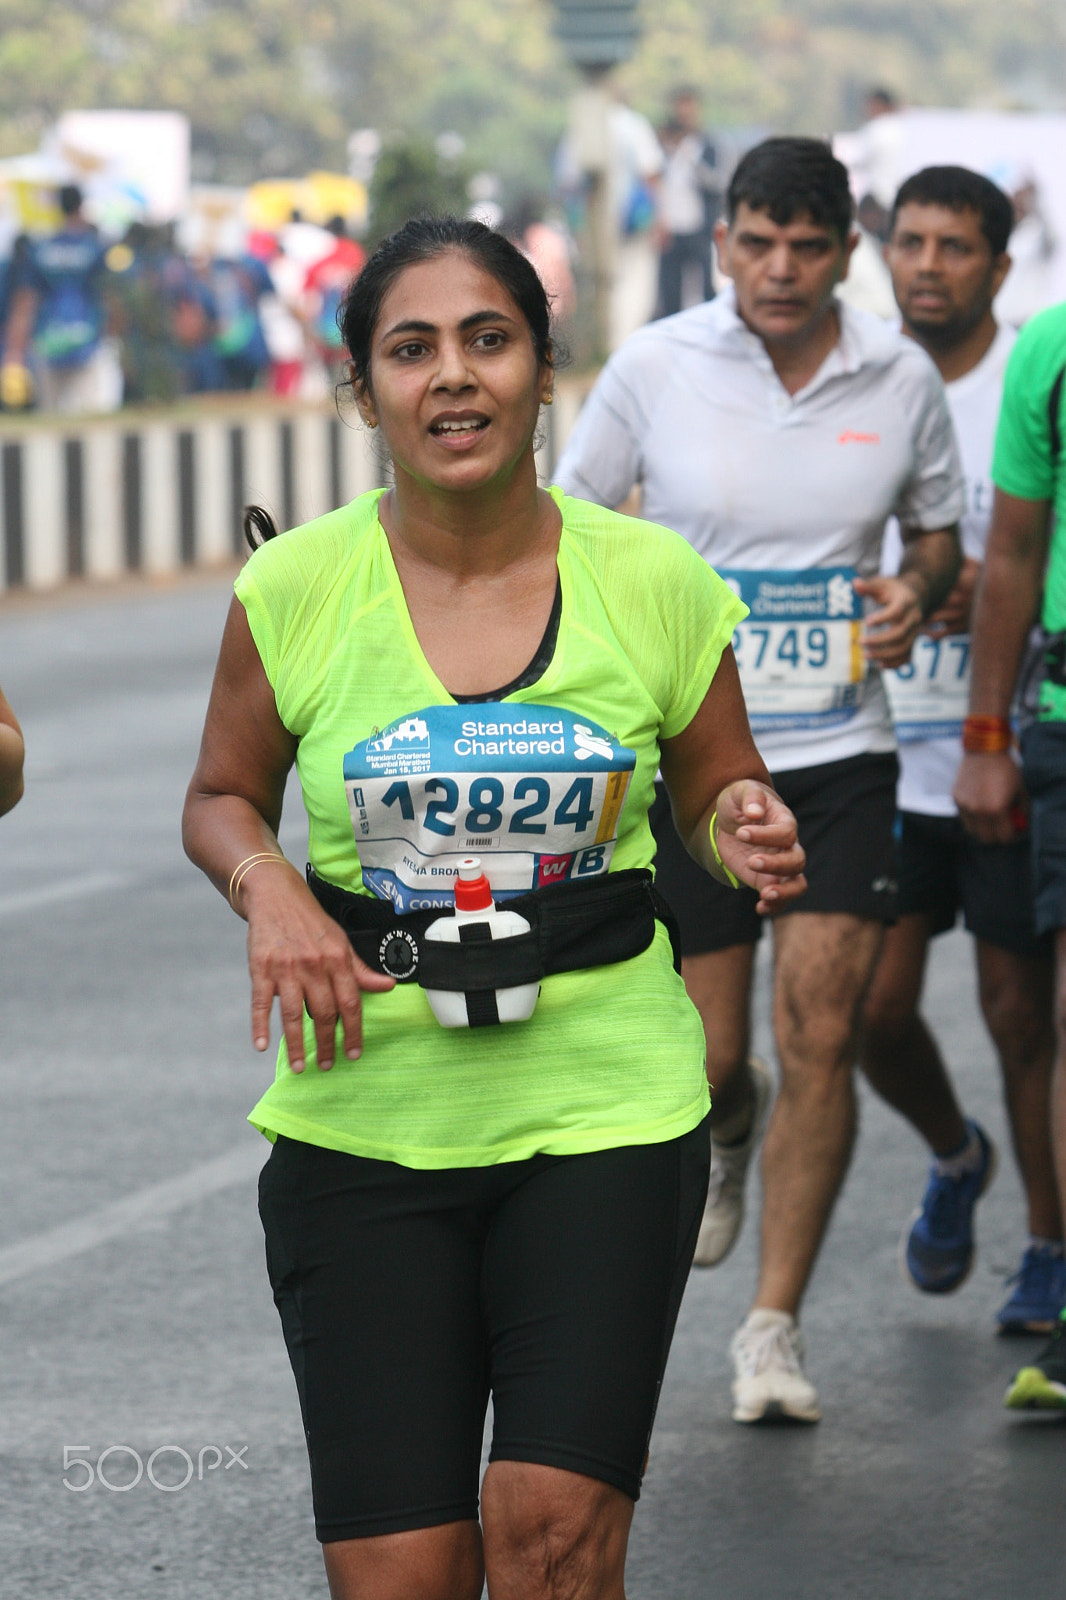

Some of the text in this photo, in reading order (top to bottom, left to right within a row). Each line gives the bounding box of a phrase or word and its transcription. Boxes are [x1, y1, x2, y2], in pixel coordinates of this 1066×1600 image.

[461, 719, 564, 738] Standard
[453, 736, 565, 757] Chartered
[366, 752, 431, 763] Standard Chartered
[371, 759, 431, 769] Mumbai Marathon
[383, 767, 398, 775] Jan
[412, 764, 431, 773] 2017
[380, 776, 595, 837] 12824
[577, 846, 606, 875] B
